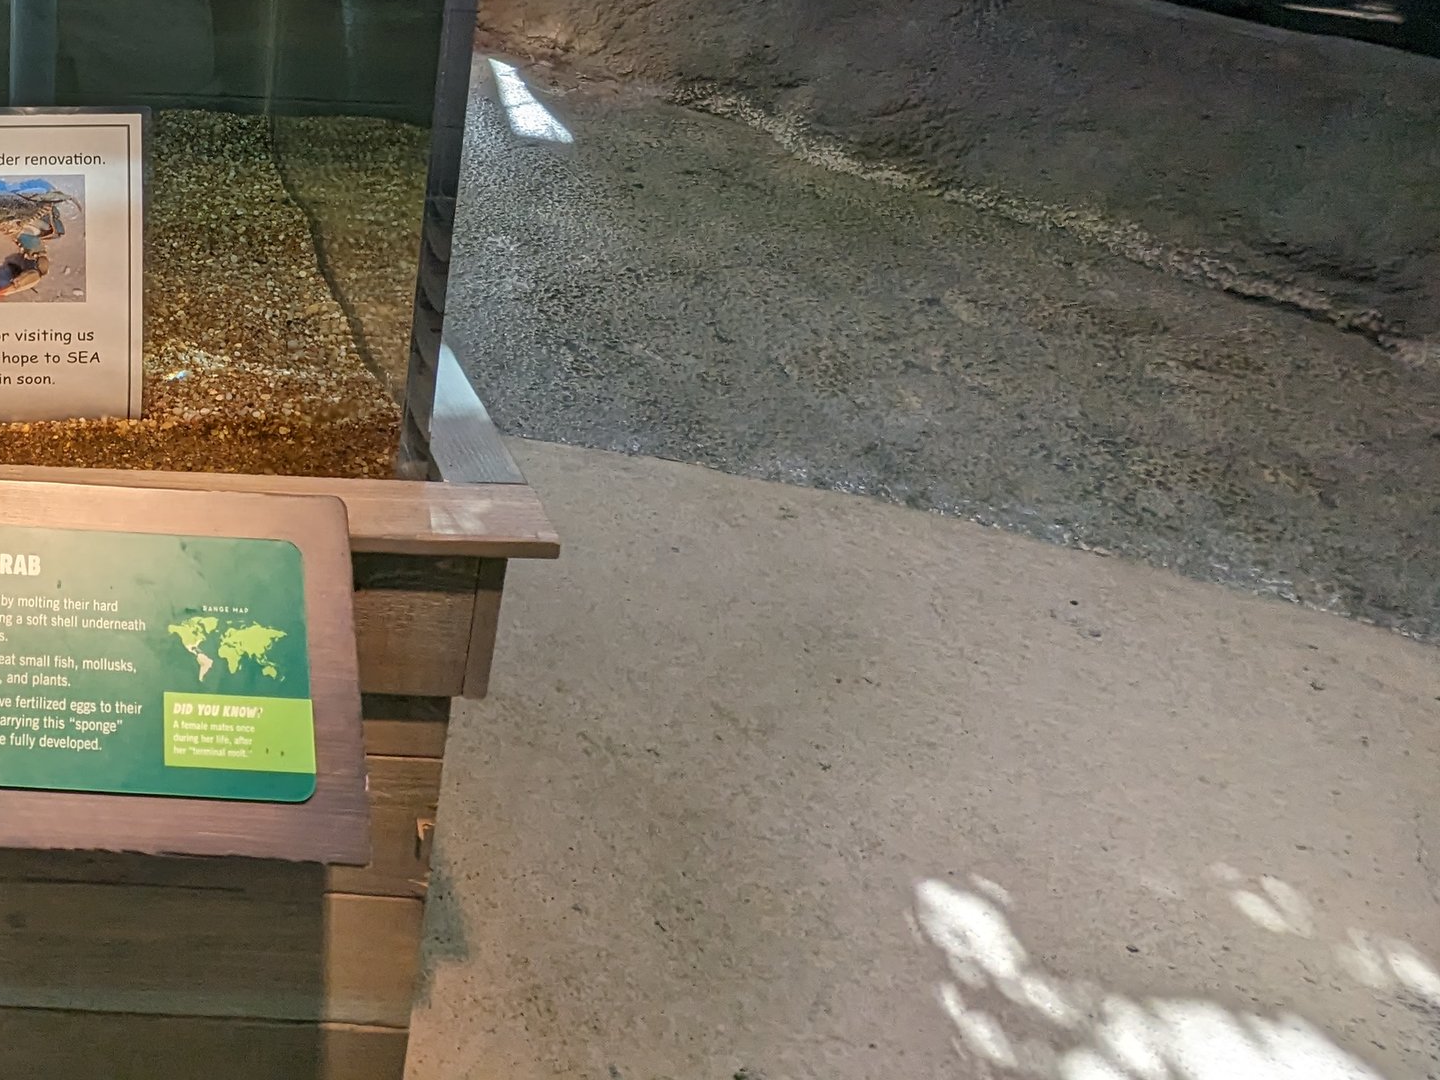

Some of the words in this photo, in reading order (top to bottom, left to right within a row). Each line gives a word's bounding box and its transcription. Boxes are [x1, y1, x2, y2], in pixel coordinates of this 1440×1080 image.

[25, 153, 106, 166] renovation.
[15, 330, 72, 345] visiting
[78, 331, 94, 342] us
[2, 352, 39, 366] hope
[44, 352, 60, 364] to
[66, 351, 100, 364] SEA
[17, 375, 55, 385] soon.
[1, 594, 14, 608] by
[18, 594, 60, 611] molting
[63, 598, 90, 610] their
[93, 600, 118, 611] hard
[203, 605, 229, 613] RANGE
[16, 615, 23, 625] a
[26, 614, 47, 626] soft
[51, 616, 78, 628] shell
[81, 618, 146, 631] underneath
[19, 654, 50, 667] small
[54, 655, 78, 670] fish,
[82, 657, 137, 673] mollusks,
[6, 673, 28, 685] and
[32, 674, 71, 687] plants.
[15, 696, 67, 711] fertilized
[70, 701, 97, 714] eggs
[100, 701, 112, 712] to
[115, 701, 143, 714] their
[173, 703, 193, 715] DID
[198, 704, 219, 716] YOU
[223, 706, 263, 719] KNOW?
[43, 716, 65, 729] this
[173, 720, 179, 729] A
[181, 721, 208, 731] female
[210, 722, 234, 732] mates
[10, 733, 35, 748] fully
[39, 735, 102, 752] developed.
[173, 733, 199, 744] during
[201, 734, 214, 744] her
[216, 735, 231, 745] life,
[234, 735, 252, 745] after
[173, 745, 186, 754] her
